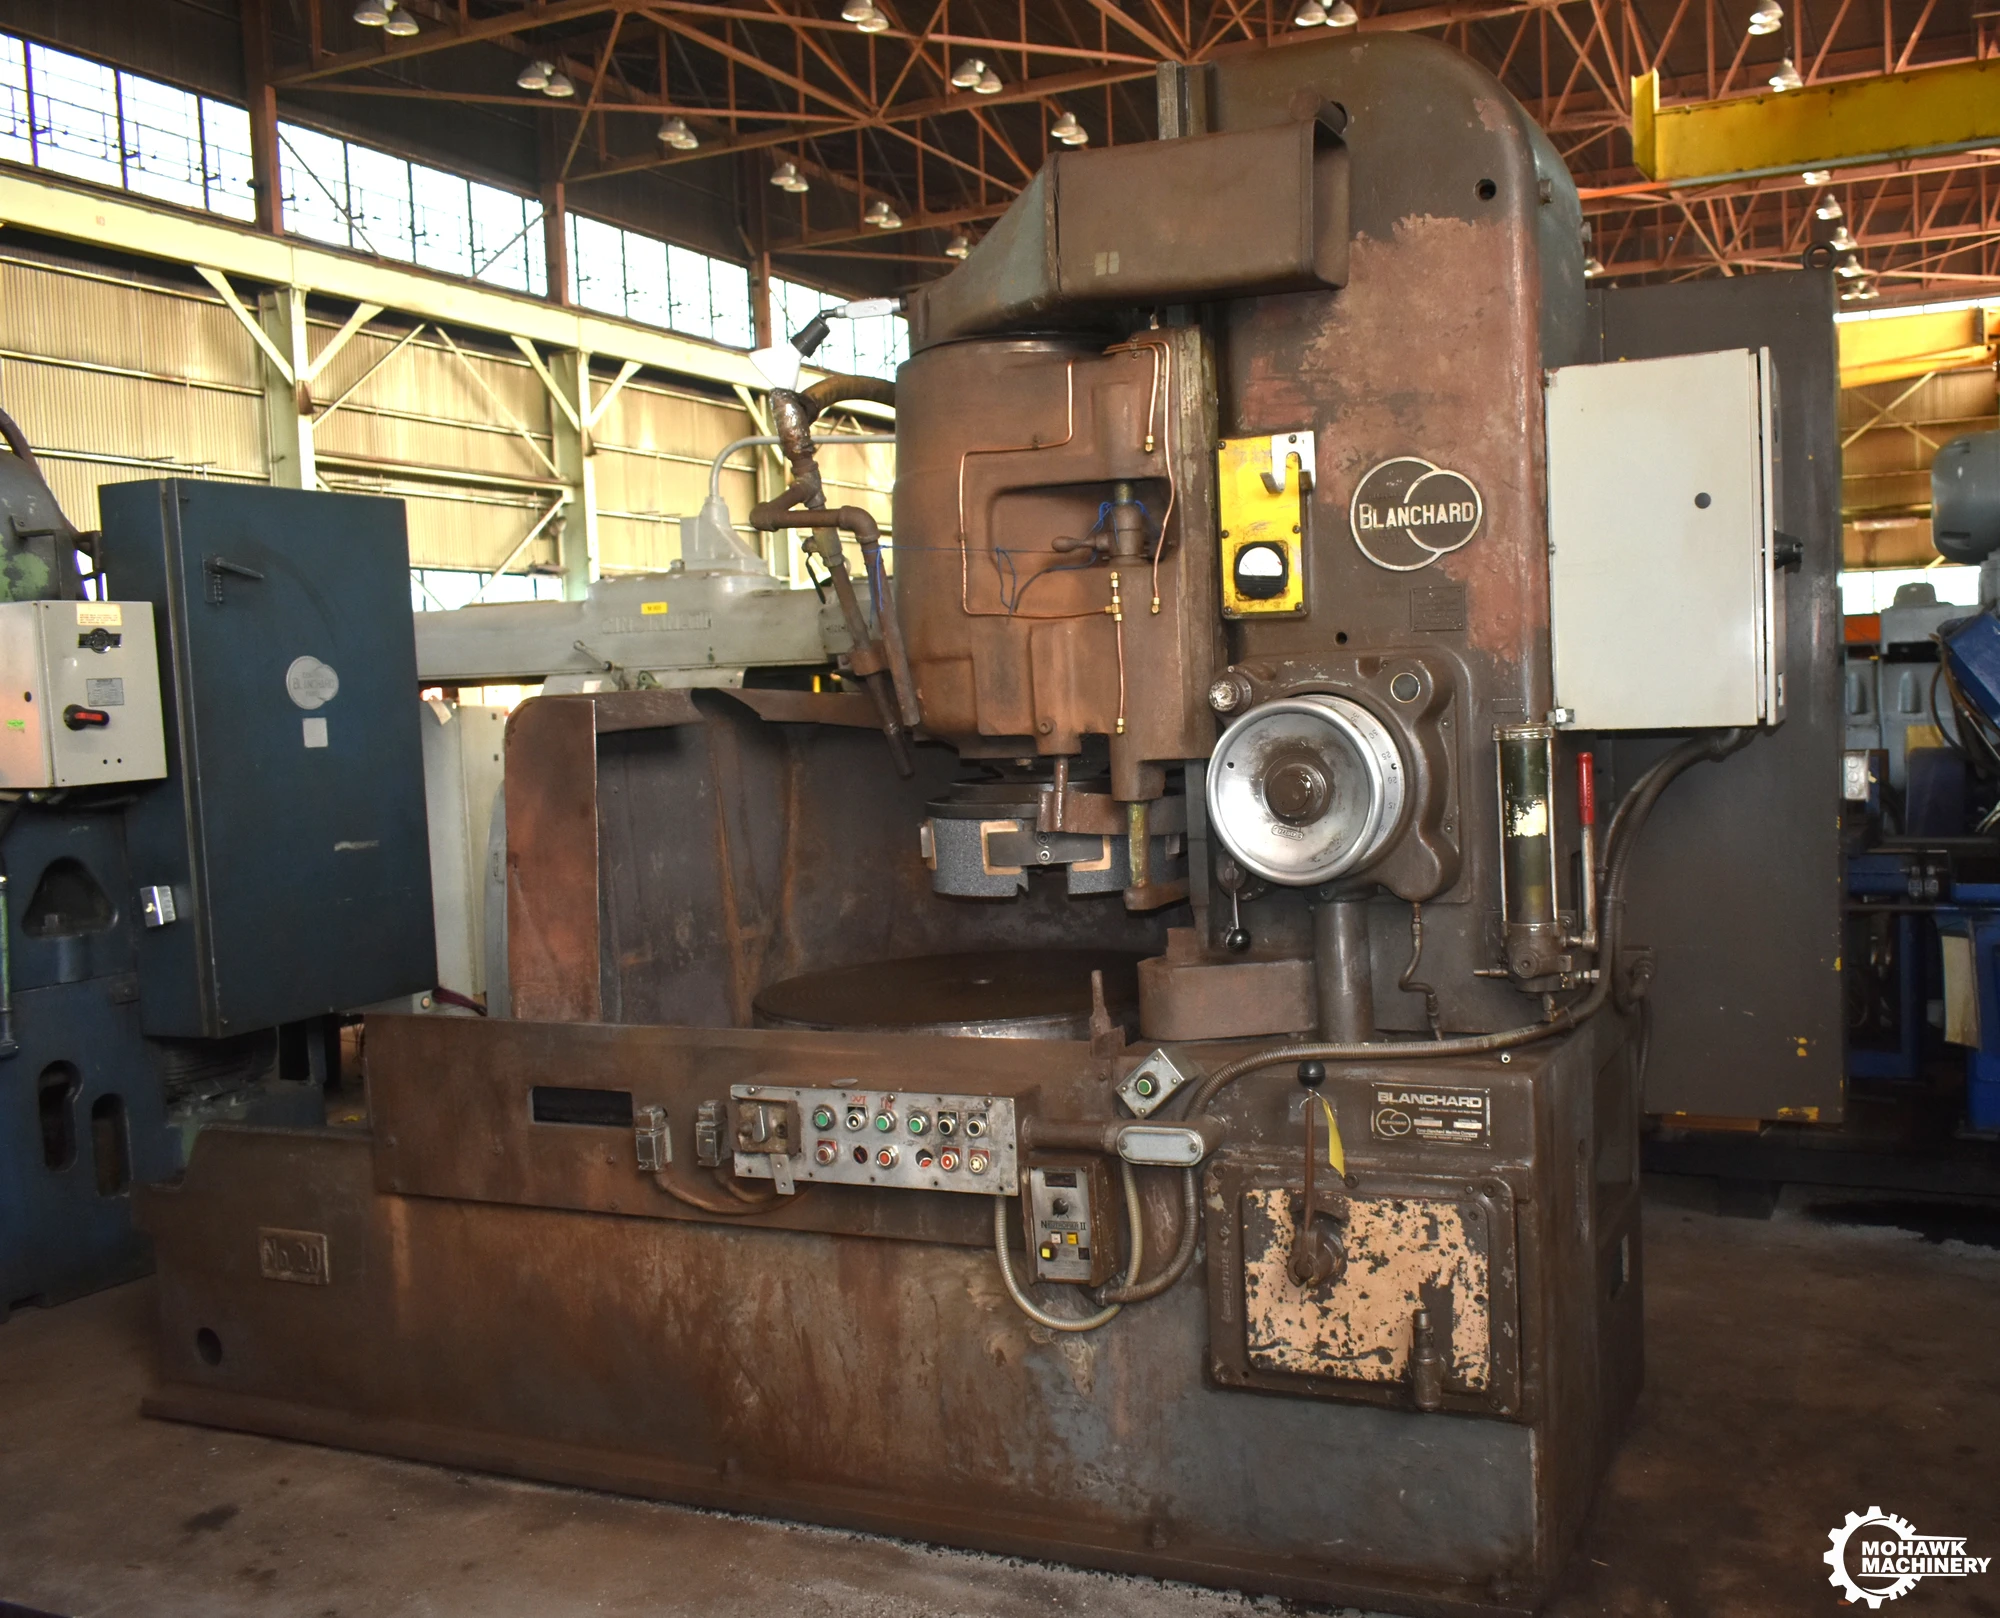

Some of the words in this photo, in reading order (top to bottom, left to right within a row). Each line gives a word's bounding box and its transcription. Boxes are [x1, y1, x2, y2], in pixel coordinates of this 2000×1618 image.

[1358, 501, 1475, 530] BLANCHARD
[1368, 728, 1379, 740] 30
[1381, 750, 1392, 760] 25
[1387, 776, 1397, 784] 20
[1388, 802, 1397, 810] 15
[1377, 1091, 1483, 1108] BLANCHARD
